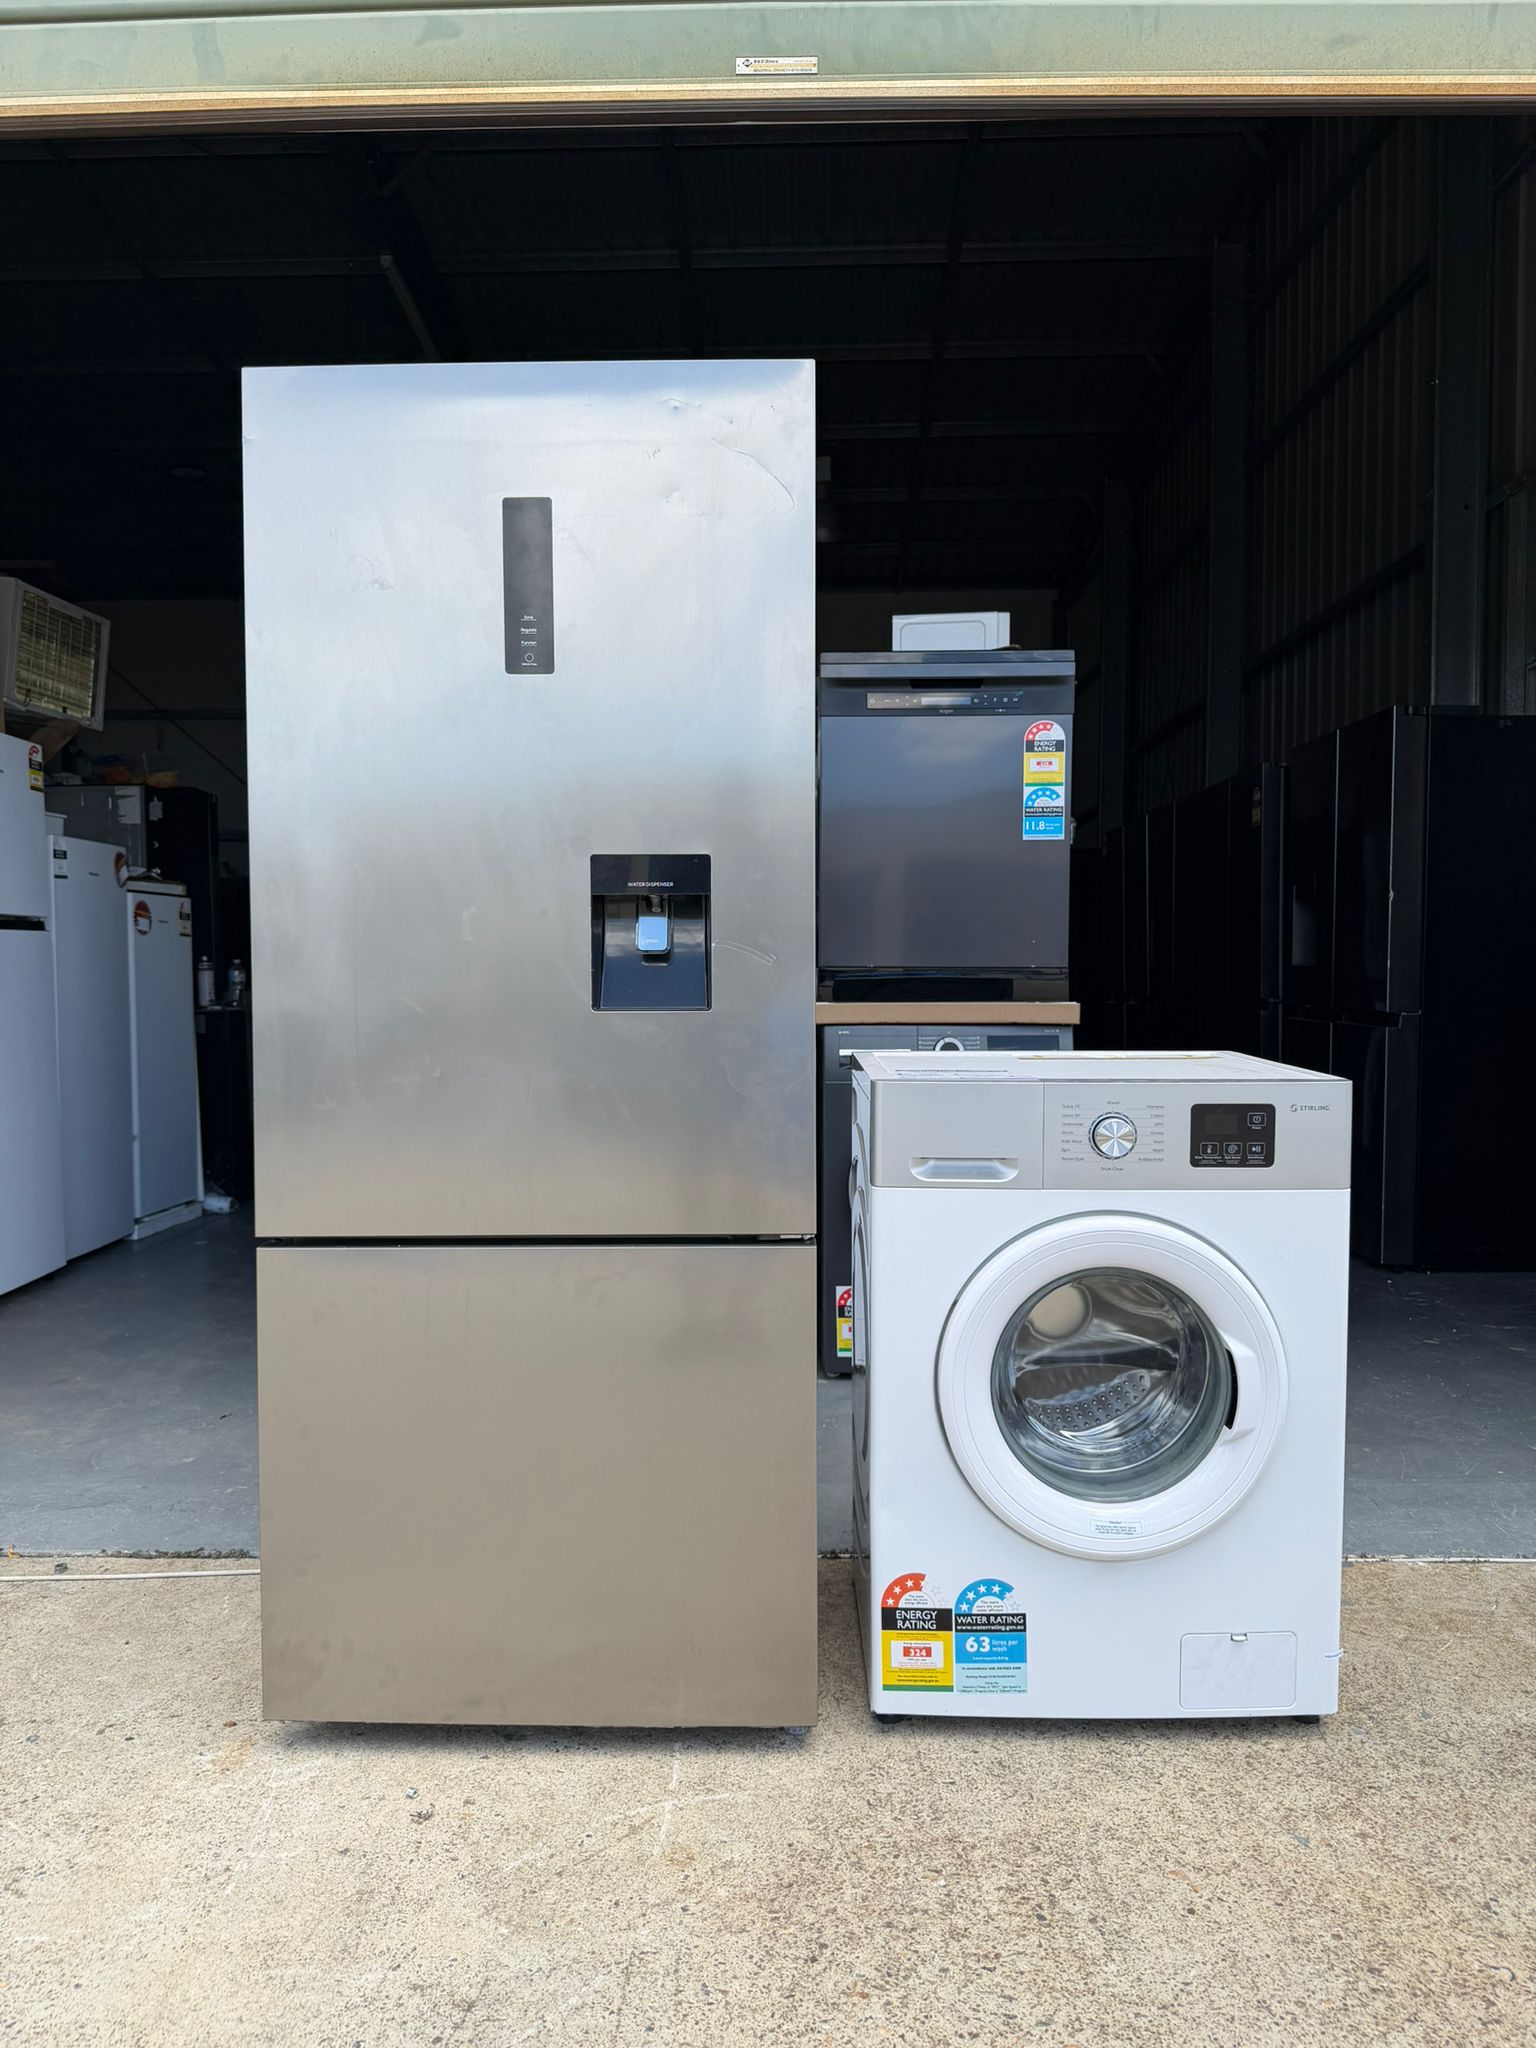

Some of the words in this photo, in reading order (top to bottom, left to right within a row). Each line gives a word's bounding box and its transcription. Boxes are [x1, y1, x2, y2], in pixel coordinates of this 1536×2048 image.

[1026, 821, 1045, 830] 11.8
[896, 1610, 938, 1620] ENERGY
[956, 1616, 988, 1624] WATER
[989, 1616, 1024, 1624] RATING
[897, 1620, 937, 1630] RATING
[965, 1636, 990, 1652] 63
[1007, 1640, 1018, 1648] per
[909, 1648, 927, 1657] 324
